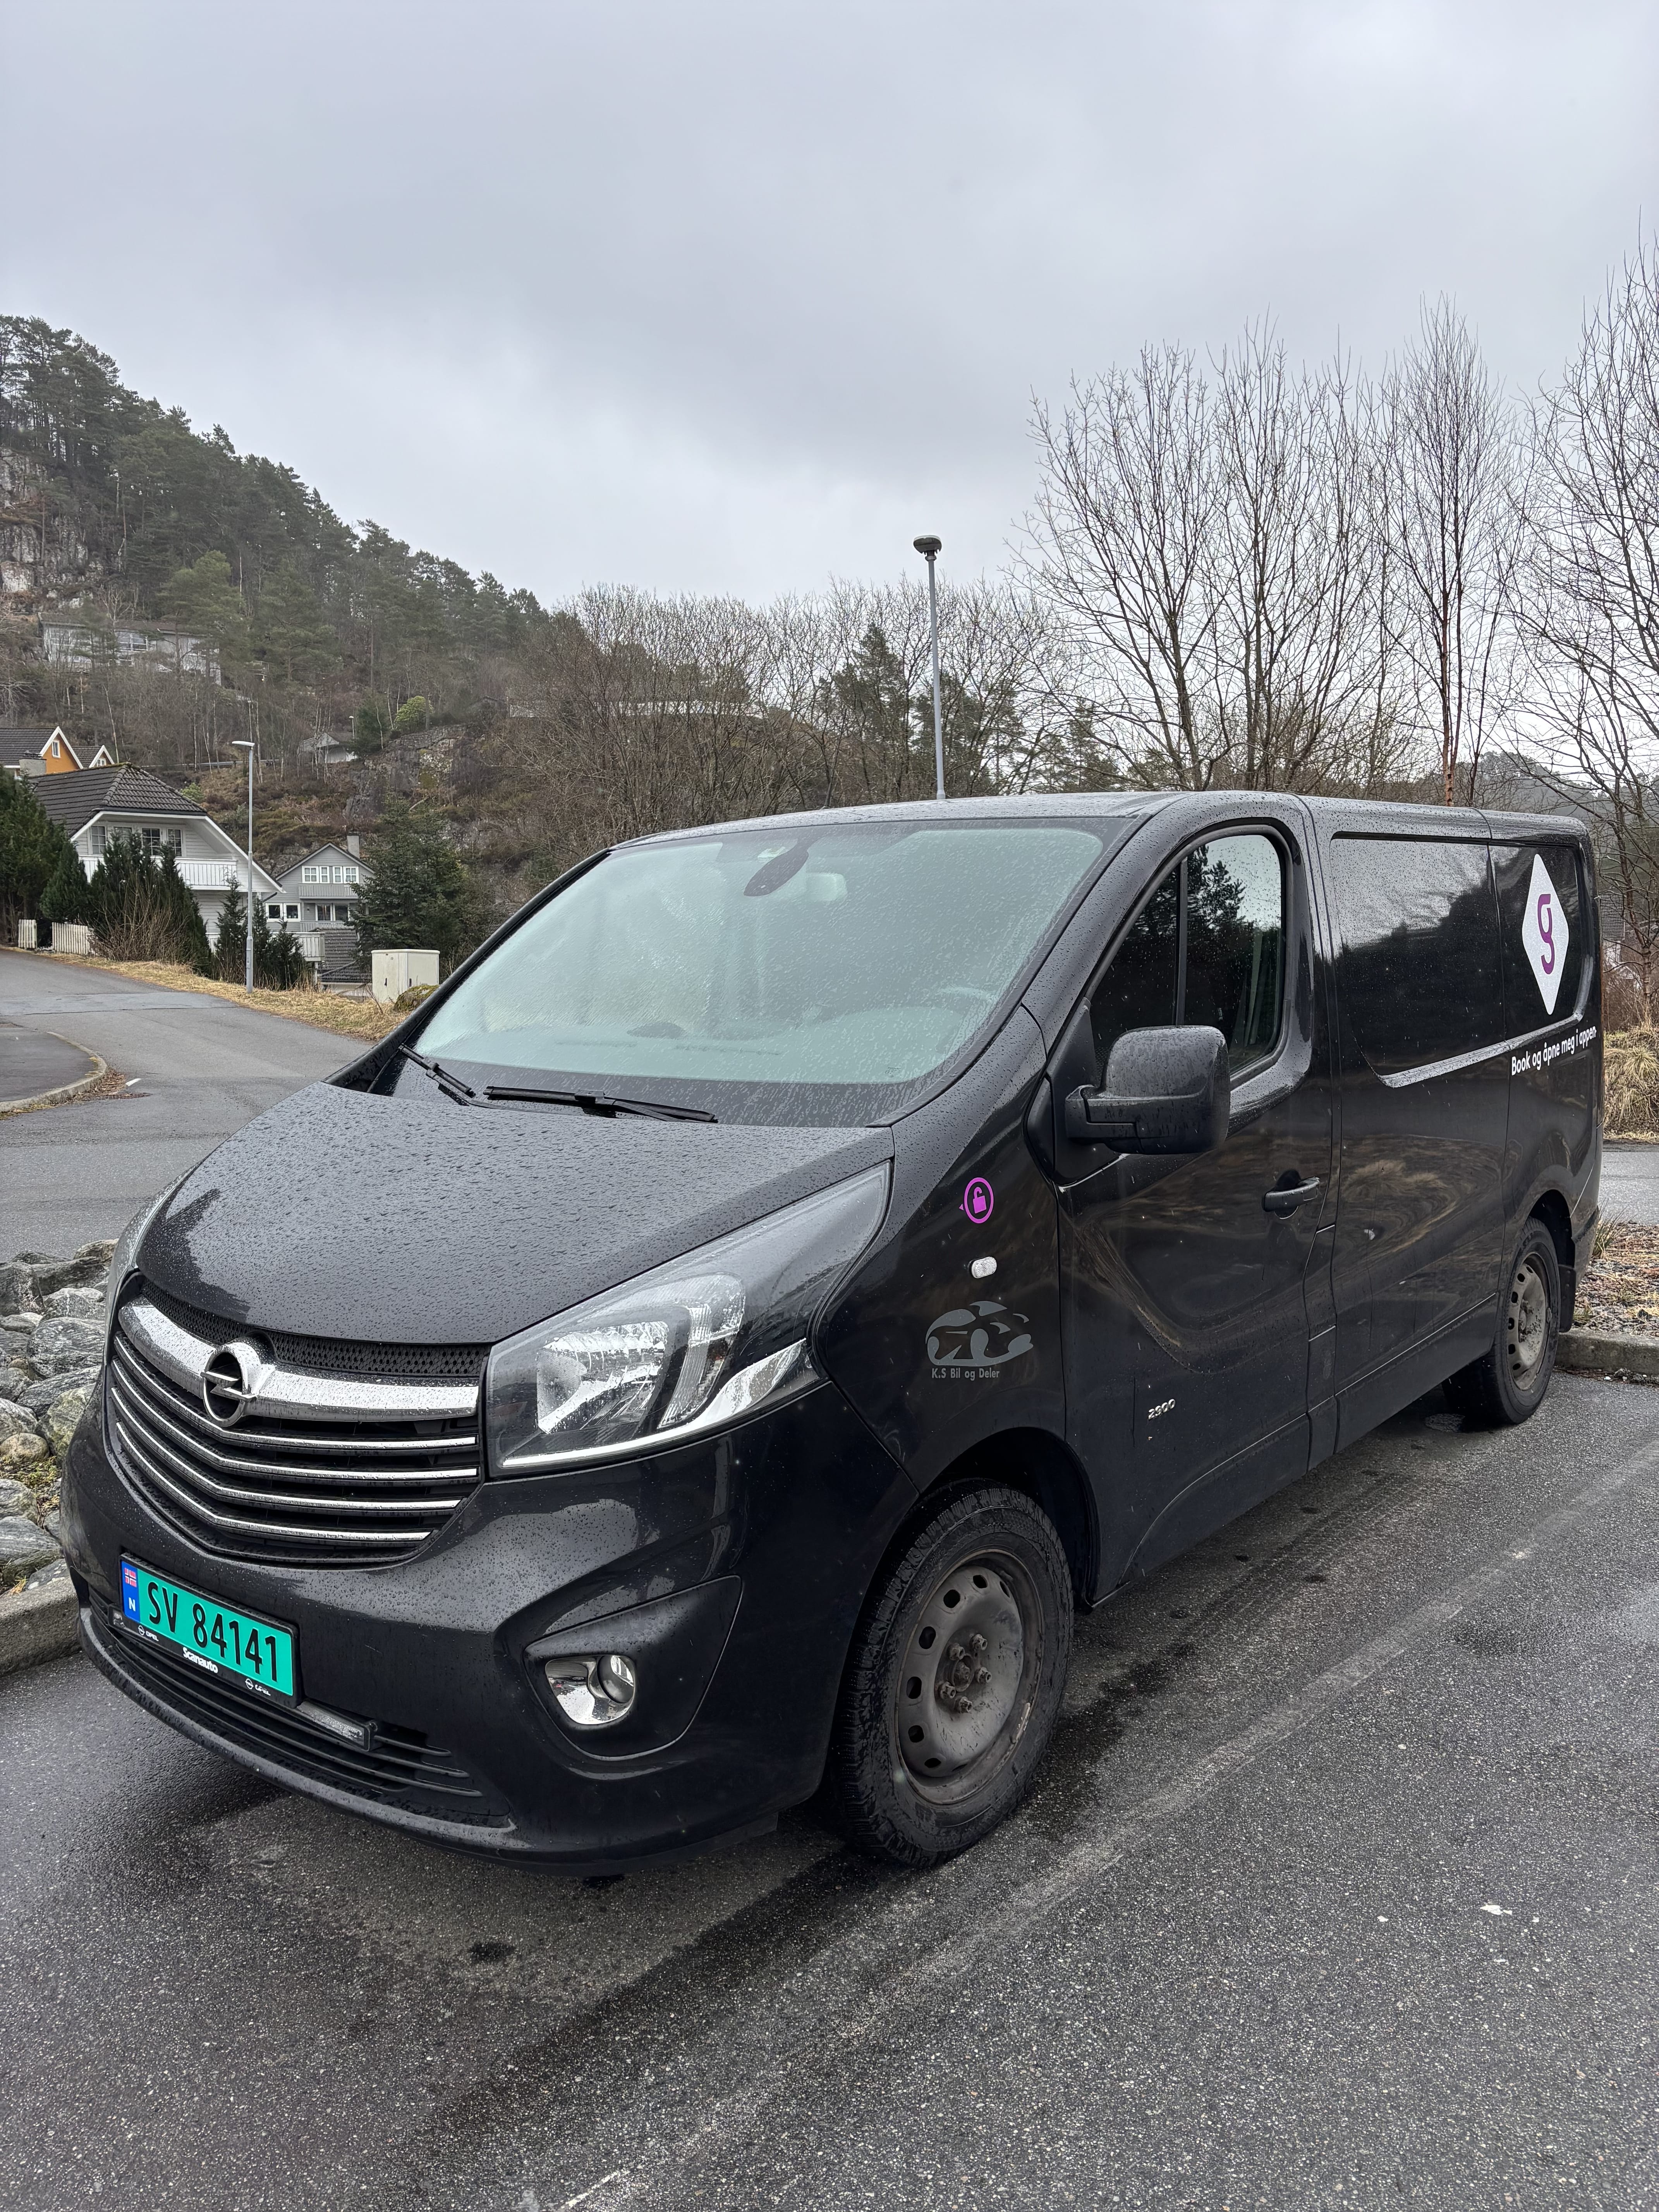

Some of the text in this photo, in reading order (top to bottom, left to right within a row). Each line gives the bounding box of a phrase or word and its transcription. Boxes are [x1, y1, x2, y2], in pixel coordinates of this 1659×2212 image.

[1512, 1051, 1530, 1075] Book
[1532, 1051, 1541, 1070] og
[1543, 1042, 1559, 1066] åpne
[1561, 1036, 1575, 1054] meg
[1576, 1029, 1578, 1046] i
[932, 1367, 1000, 1381] K.S Bil og Deler
[1148, 1398, 1176, 1420] 2900
[128, 1597, 136, 1611] N
[146, 1631, 159, 1641] OPEL
[148, 1582, 277, 1682] SV 84141
[183, 1647, 218, 1673] Scanauto
